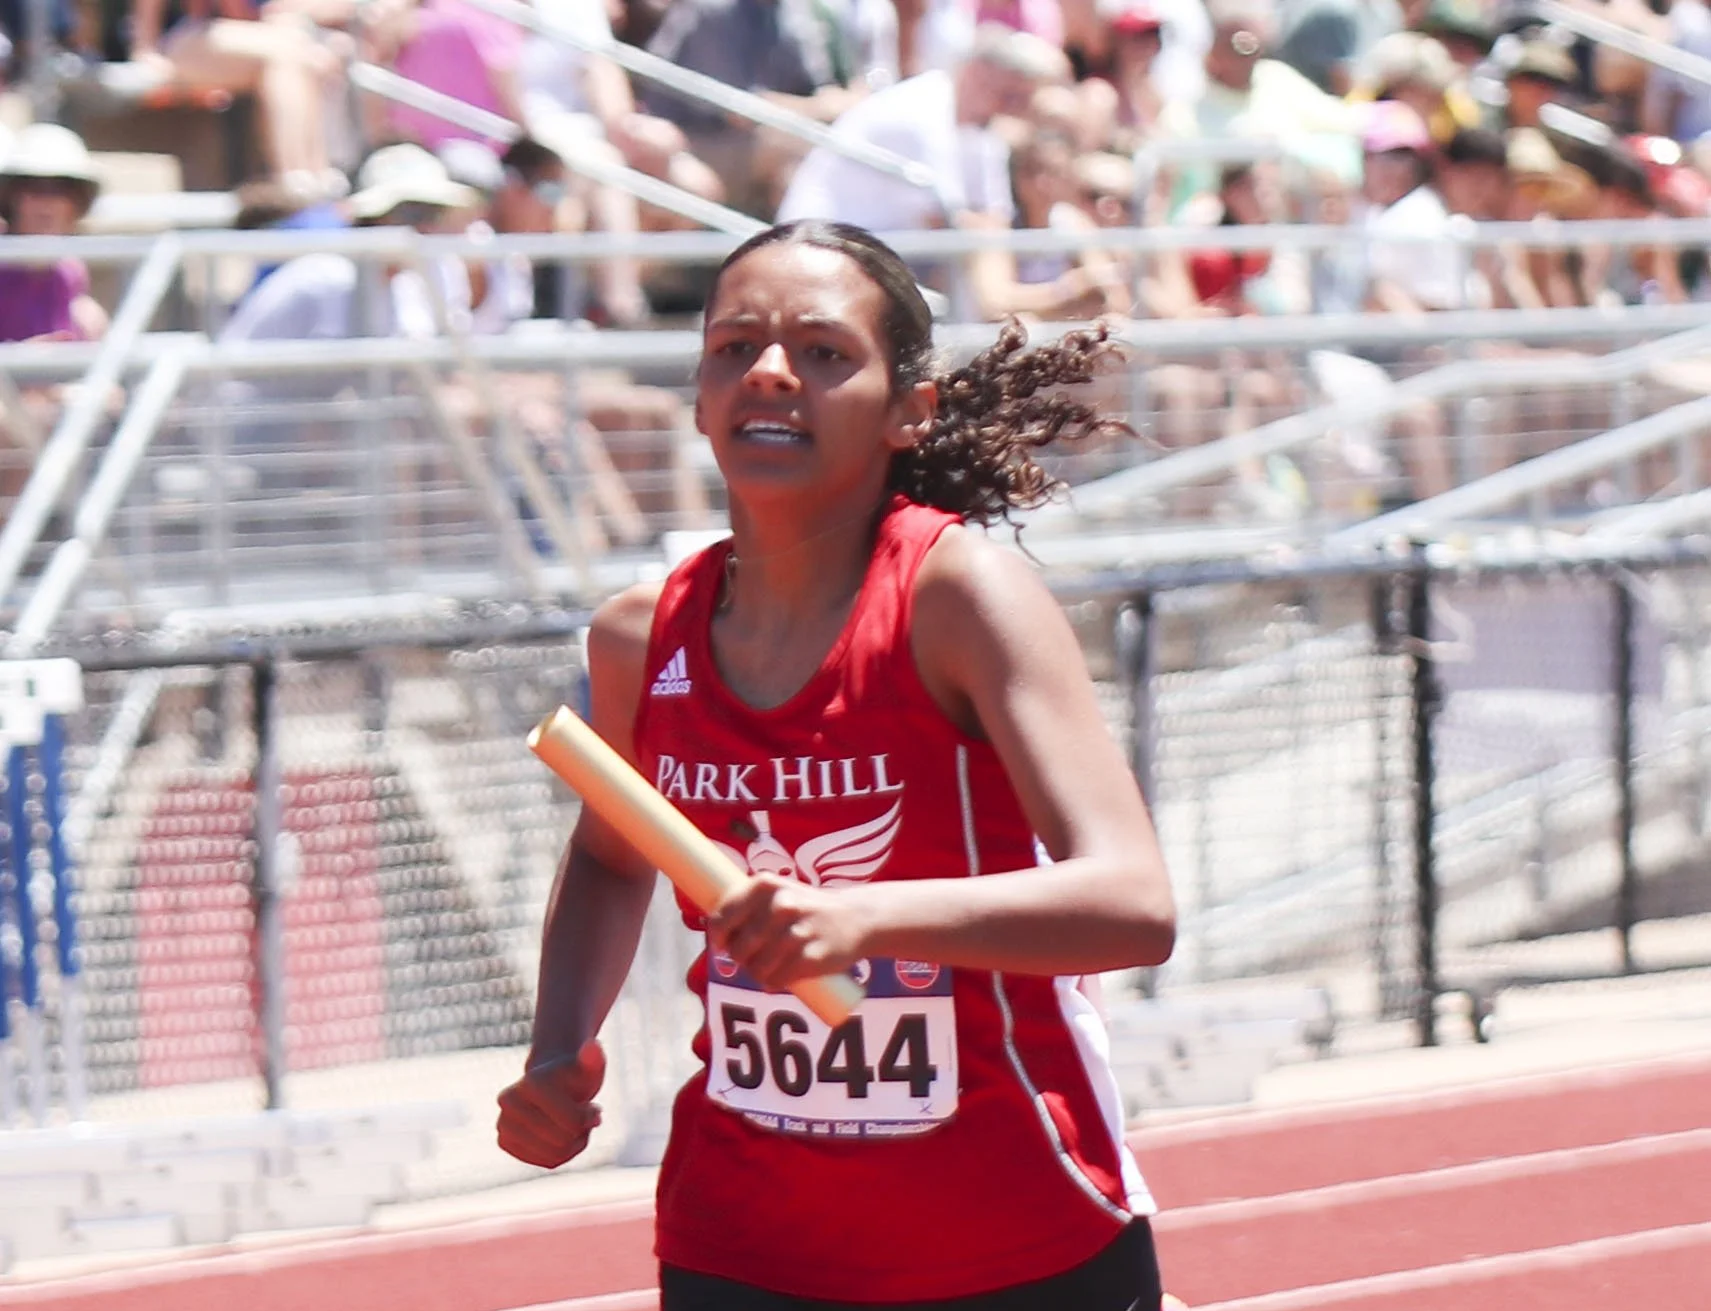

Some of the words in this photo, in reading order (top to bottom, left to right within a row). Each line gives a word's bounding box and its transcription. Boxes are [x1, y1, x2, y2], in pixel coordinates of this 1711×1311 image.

[650, 677, 692, 696] adidas
[657, 755, 760, 802] PARK
[769, 753, 905, 802] HILL
[720, 1002, 937, 1099] 5644
